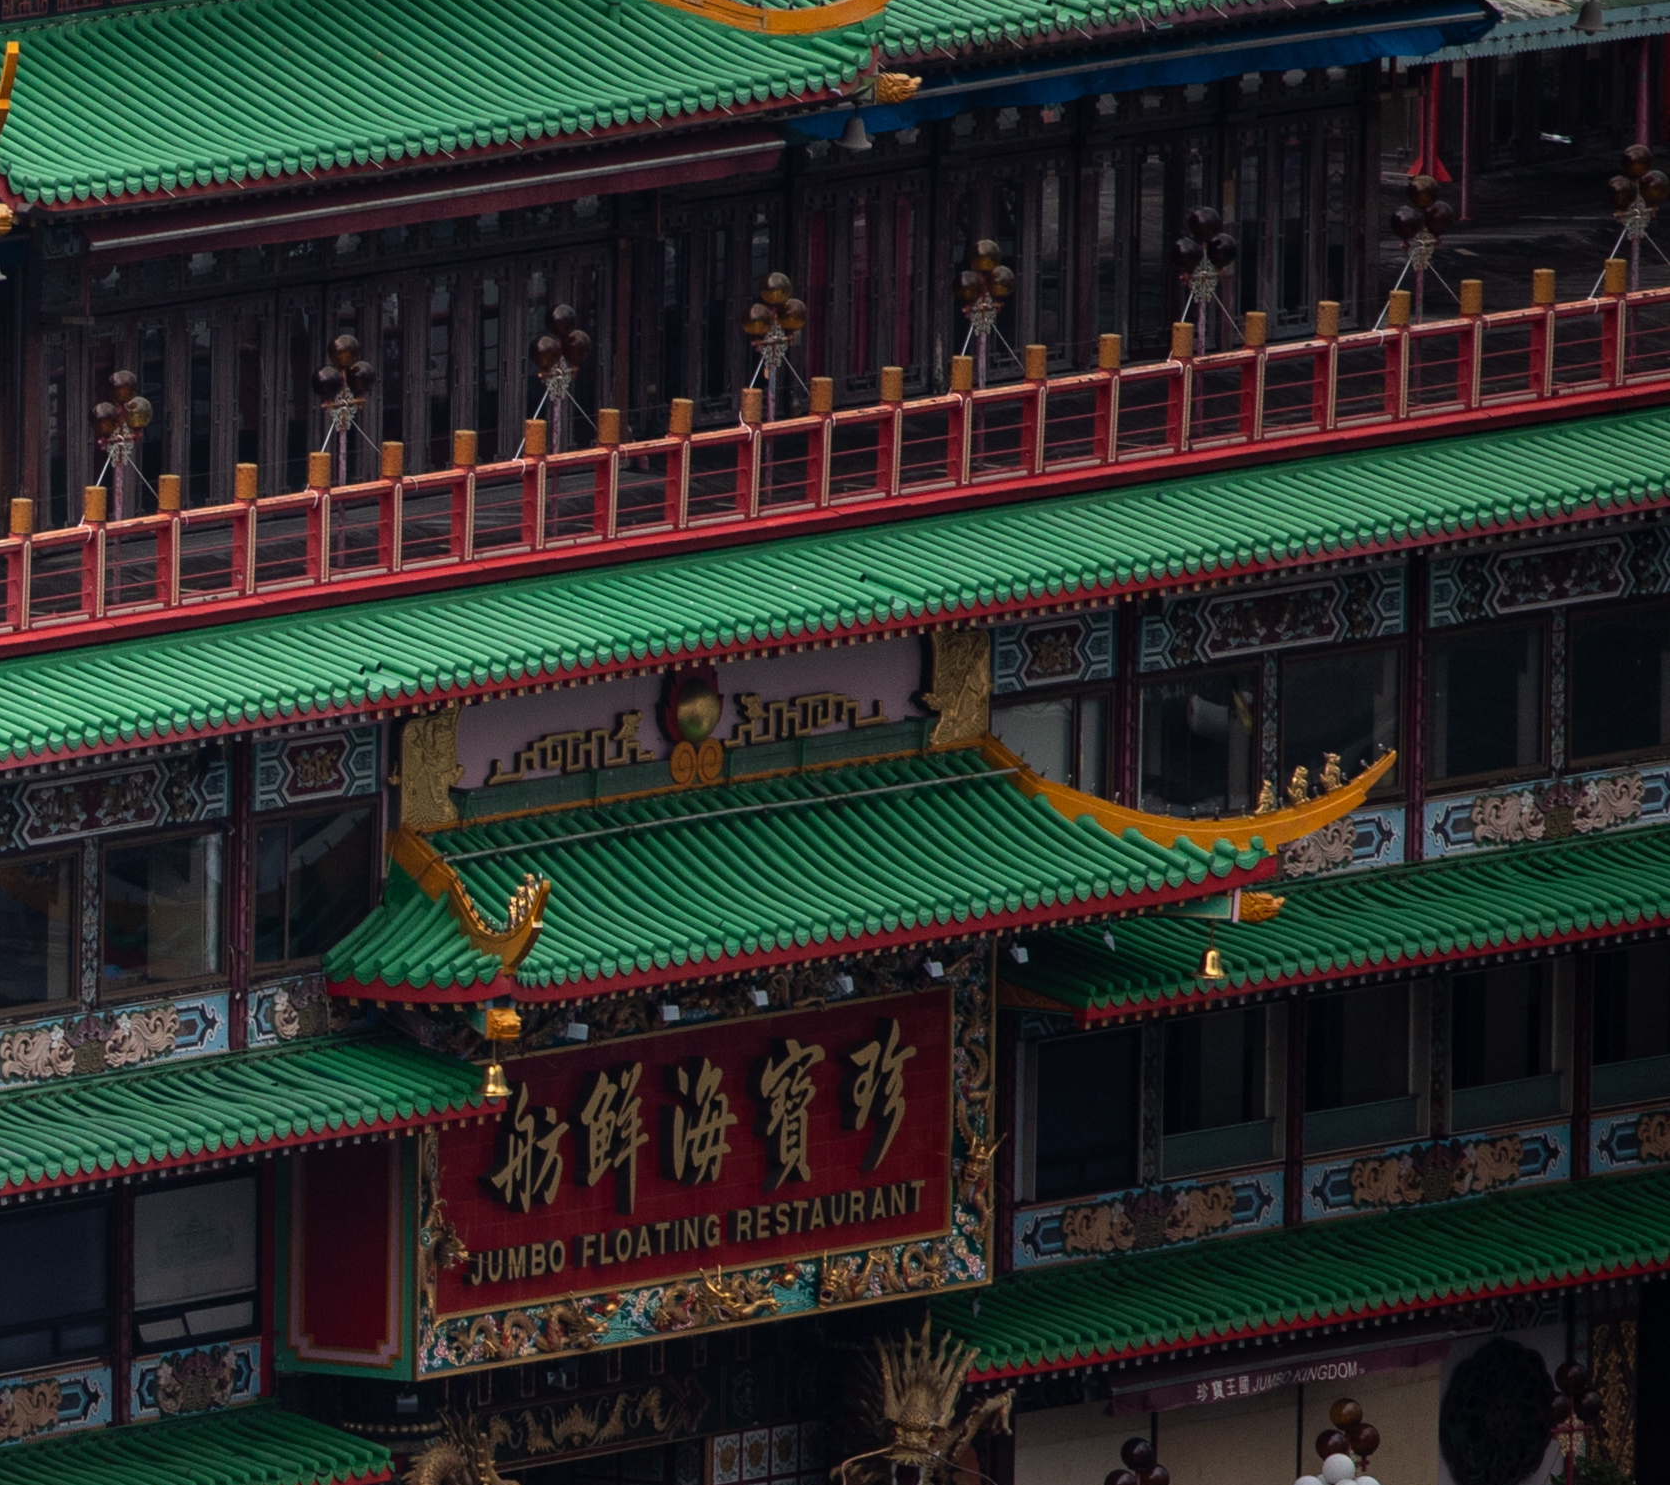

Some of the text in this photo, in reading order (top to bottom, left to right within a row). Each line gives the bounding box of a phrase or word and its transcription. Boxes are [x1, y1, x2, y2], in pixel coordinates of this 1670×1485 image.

[471, 1180, 926, 1287] JUMBO FLOATING RESTAURANT
[1195, 1361, 1358, 1401] 珍寶王國 JUMBO KINGDOM
